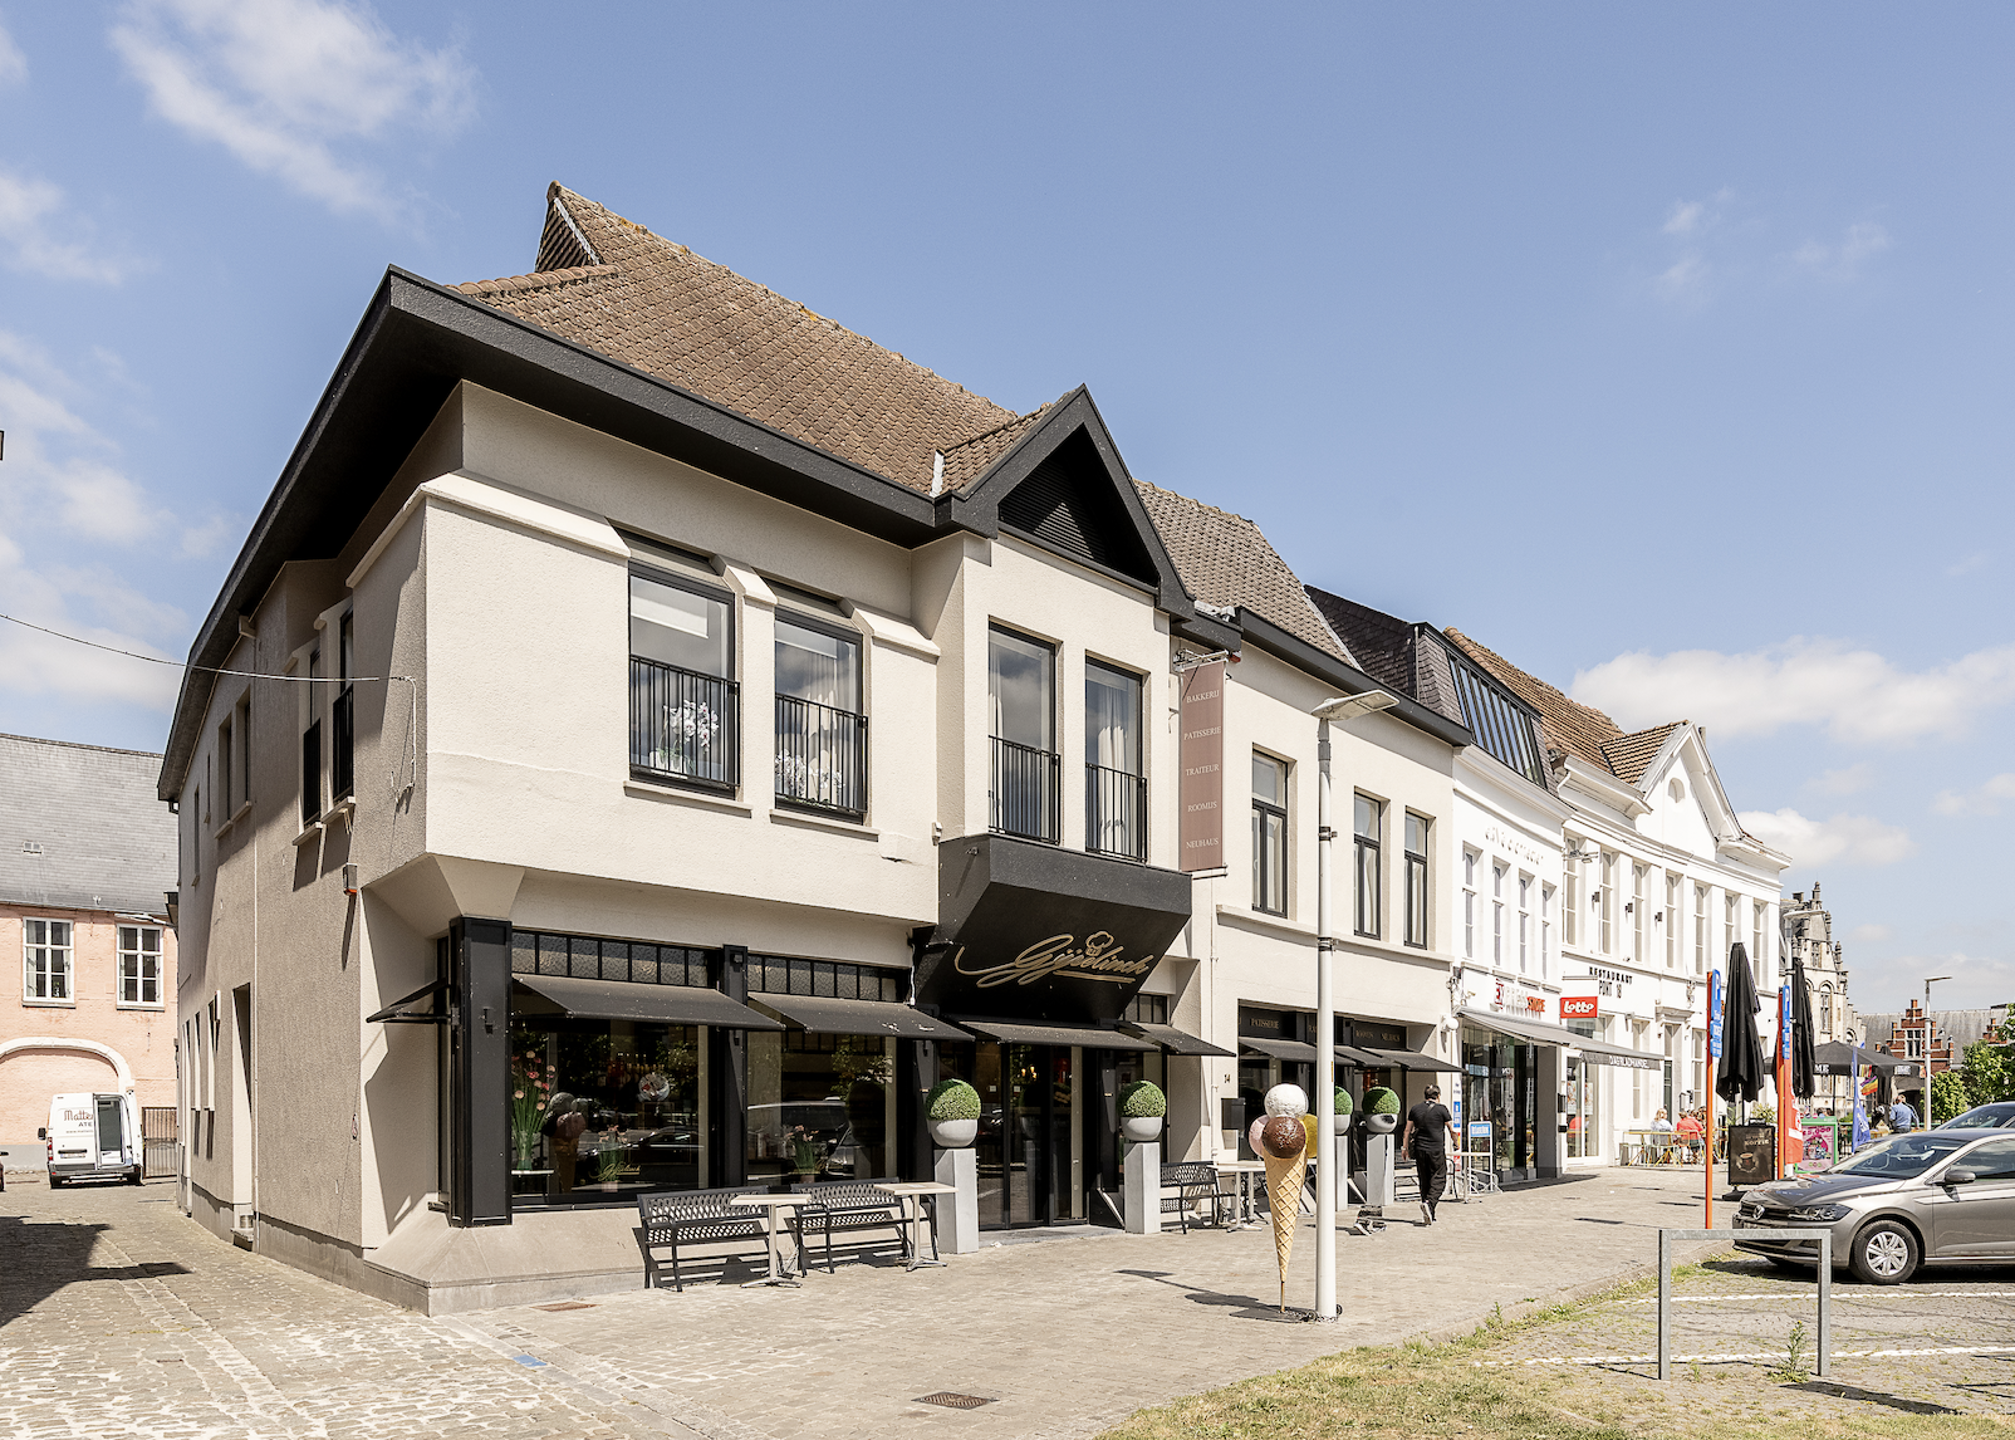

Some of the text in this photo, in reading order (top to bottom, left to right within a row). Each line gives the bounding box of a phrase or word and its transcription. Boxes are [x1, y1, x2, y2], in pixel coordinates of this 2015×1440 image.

[1186, 689, 1220, 703] BAKKERIJ
[1184, 726, 1222, 741] PATISSERIE
[1185, 763, 1220, 776] TRAITEUR
[1186, 837, 1219, 849] NEUHAUS
[1589, 966, 1633, 985] RESTAURANT
[1563, 1000, 1595, 1014] Lotto
